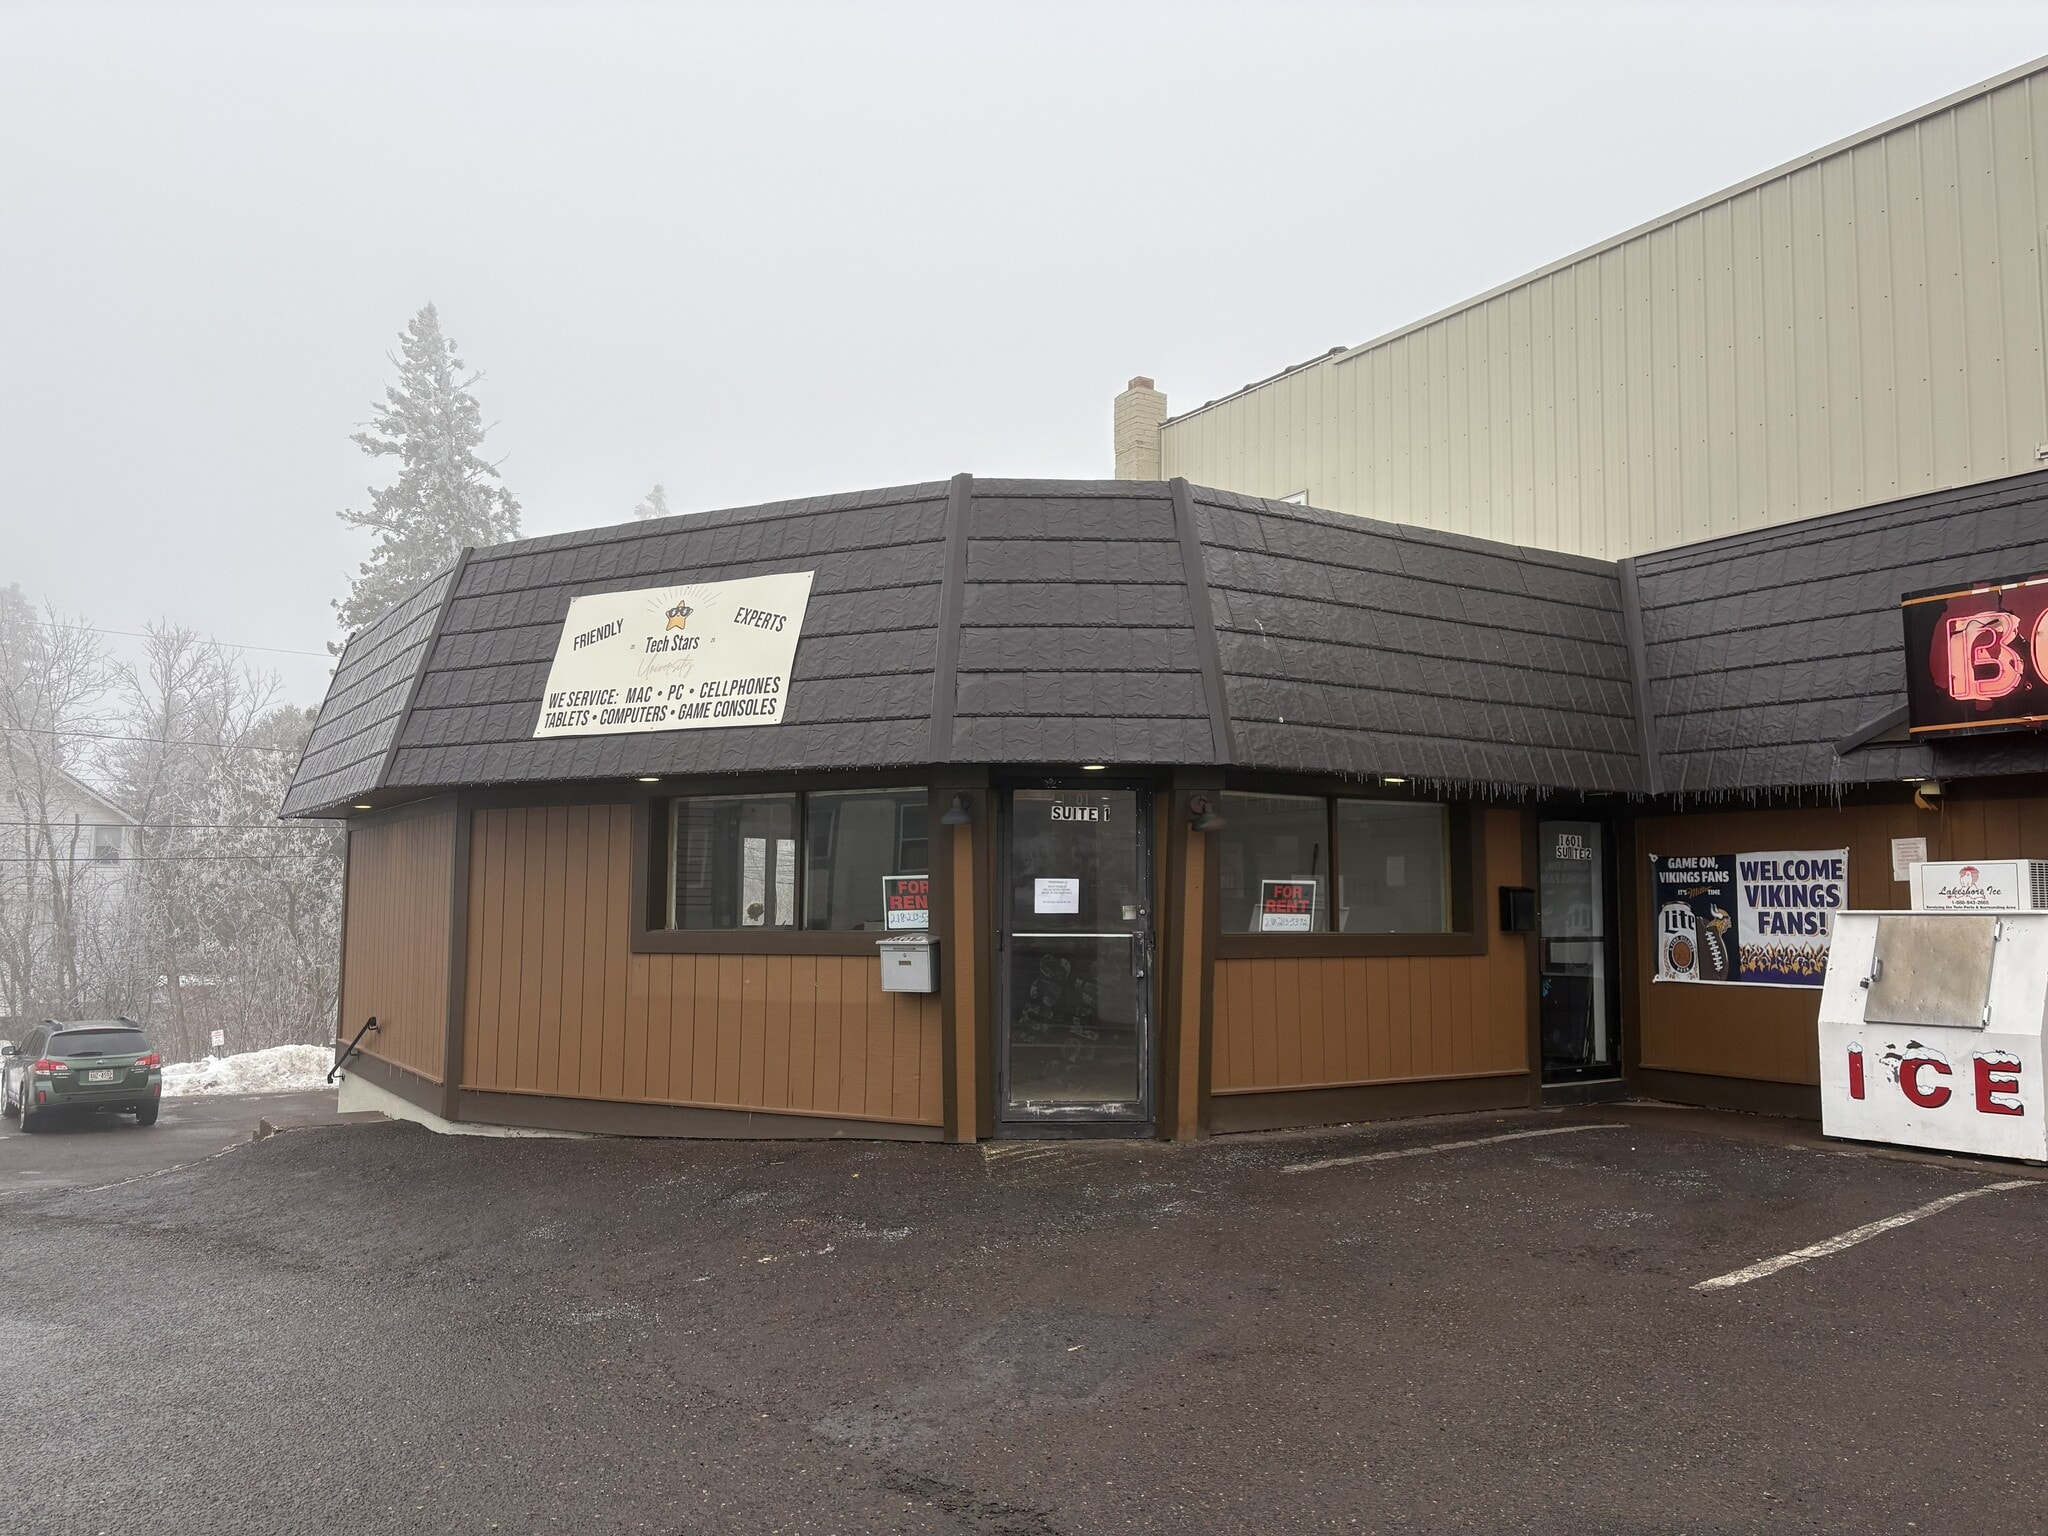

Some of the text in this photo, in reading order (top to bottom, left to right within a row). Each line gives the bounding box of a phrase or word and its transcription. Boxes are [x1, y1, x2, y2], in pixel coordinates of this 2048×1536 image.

[733, 607, 787, 632] EXPERTS
[573, 618, 624, 651] FRIENDLY
[645, 634, 700, 653] Tech Stars
[637, 653, 694, 680] University
[549, 676, 781, 709] WE SERVICE: MAC PC CELLPHONES
[544, 698, 777, 728] TABLETS COMPUTERS GAME CONSOLES
[1052, 806, 1110, 821] SUITE 1
[1560, 835, 1581, 847] 1601
[1668, 856, 1719, 869] GAME ON,
[1739, 859, 1844, 882] WELCOME
[1659, 870, 1729, 883] VIKINGS FANS
[889, 895, 928, 910] REN
[1274, 885, 1303, 898] FOR
[1744, 884, 1842, 909] VIKINGS
[1939, 886, 2002, 896] Lakeshore Ice
[1265, 899, 1309, 913] RENT
[1664, 910, 1694, 934] Lite
[1758, 911, 1828, 936] FANS!
[1847, 1041, 2025, 1117] ICE
